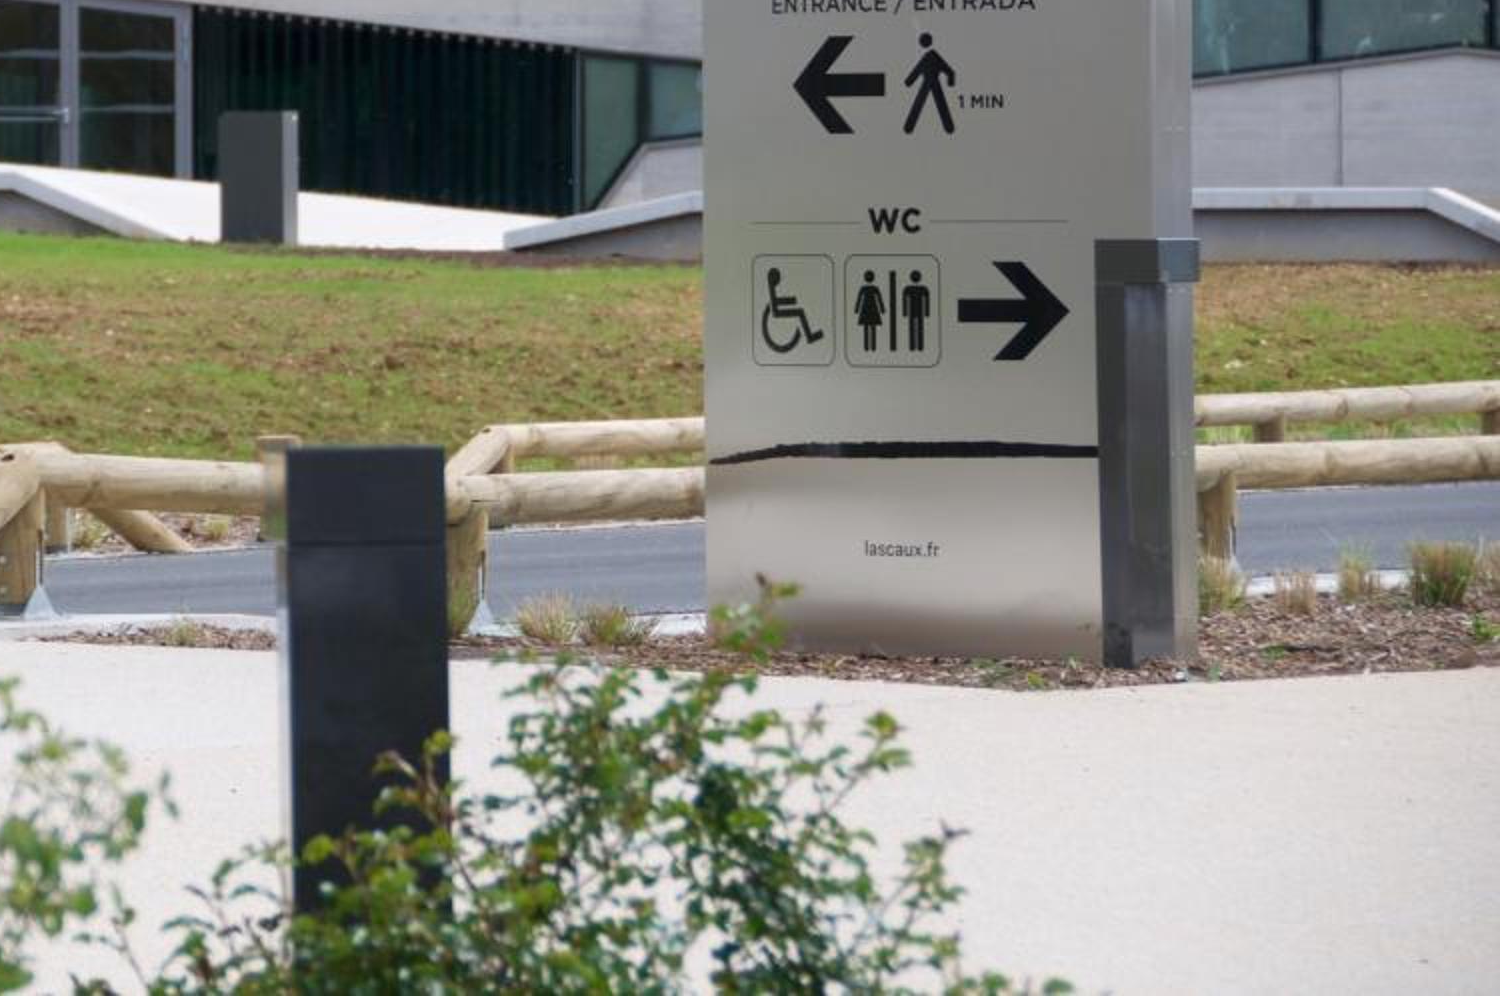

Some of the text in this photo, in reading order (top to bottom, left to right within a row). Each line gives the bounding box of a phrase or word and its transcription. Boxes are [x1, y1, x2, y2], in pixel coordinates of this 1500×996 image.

[958, 94, 1004, 108] 1 MIN
[868, 208, 922, 233] WC
[864, 539, 940, 558] lascaux.fr
